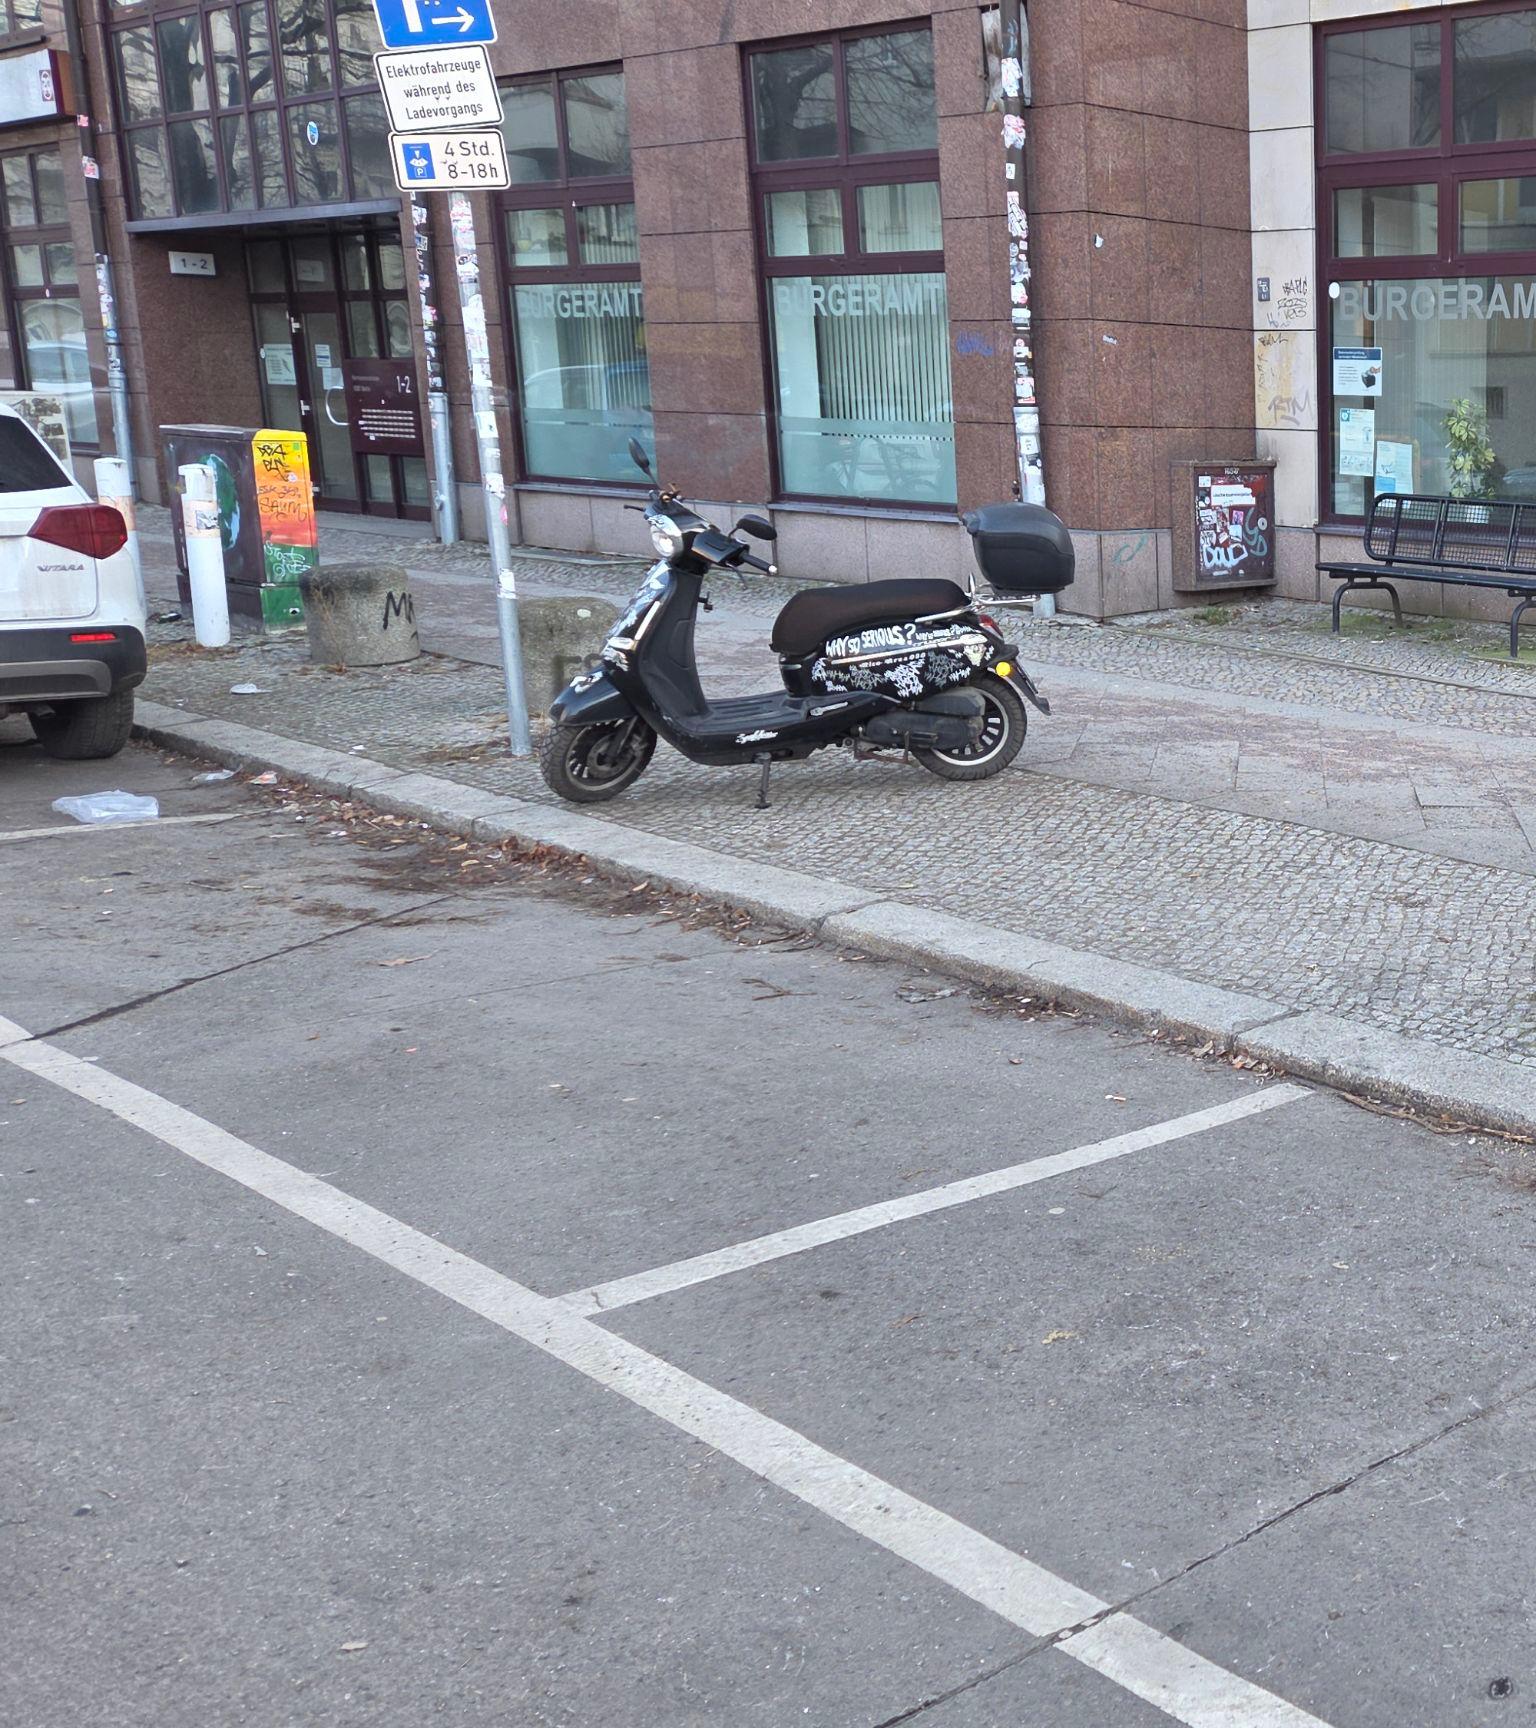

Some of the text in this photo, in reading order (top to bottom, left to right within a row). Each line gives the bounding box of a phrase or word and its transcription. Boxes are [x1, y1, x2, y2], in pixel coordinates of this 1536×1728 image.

[386, 59, 481, 79] Elektrofahrzeuge
[404, 80, 476, 98] während des
[406, 102, 483, 120] Ladevorgangs
[445, 141, 495, 157] 4 Std.
[448, 163, 499, 179] 8-18h
[826, 636, 849, 658] WHY
